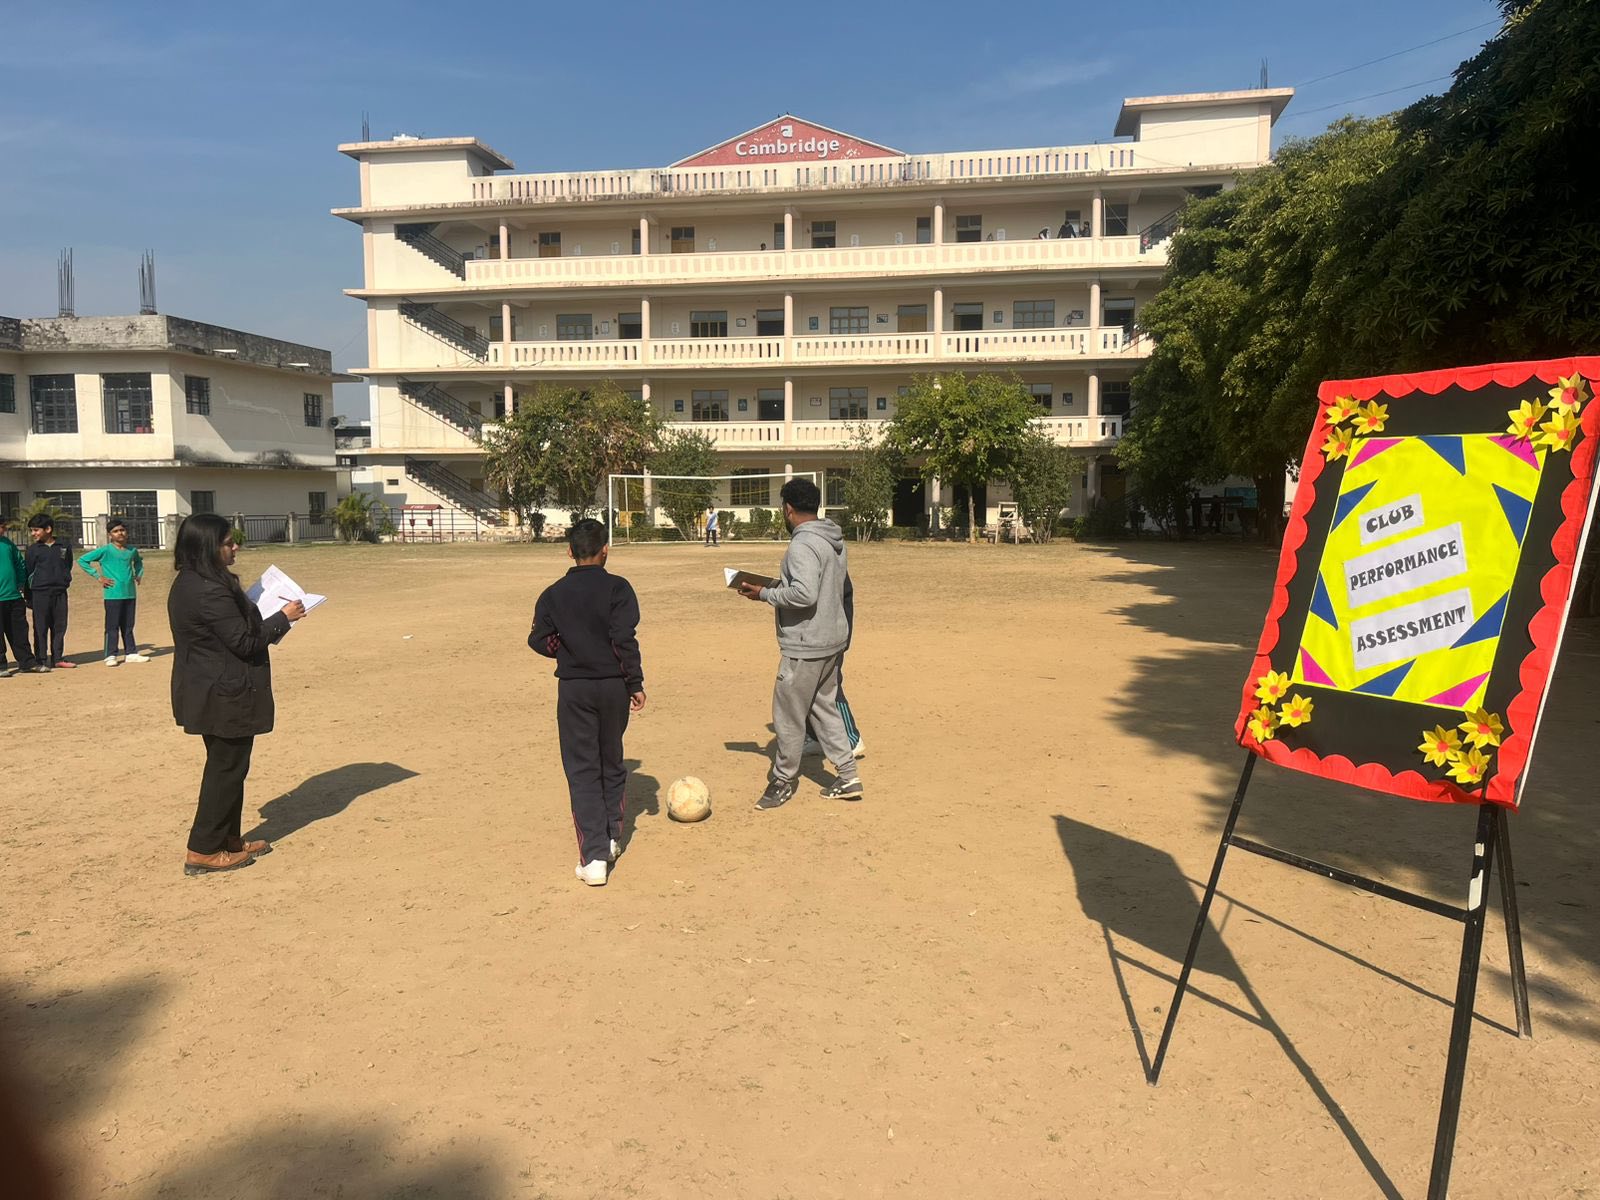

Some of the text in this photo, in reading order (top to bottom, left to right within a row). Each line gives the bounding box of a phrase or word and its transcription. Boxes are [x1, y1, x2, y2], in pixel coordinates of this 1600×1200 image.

[735, 137, 839, 158] Cambridge
[1366, 504, 1414, 533] CLUB
[1350, 540, 1458, 591] PERFORMANCE
[1357, 605, 1466, 652] ASSESSMENT
